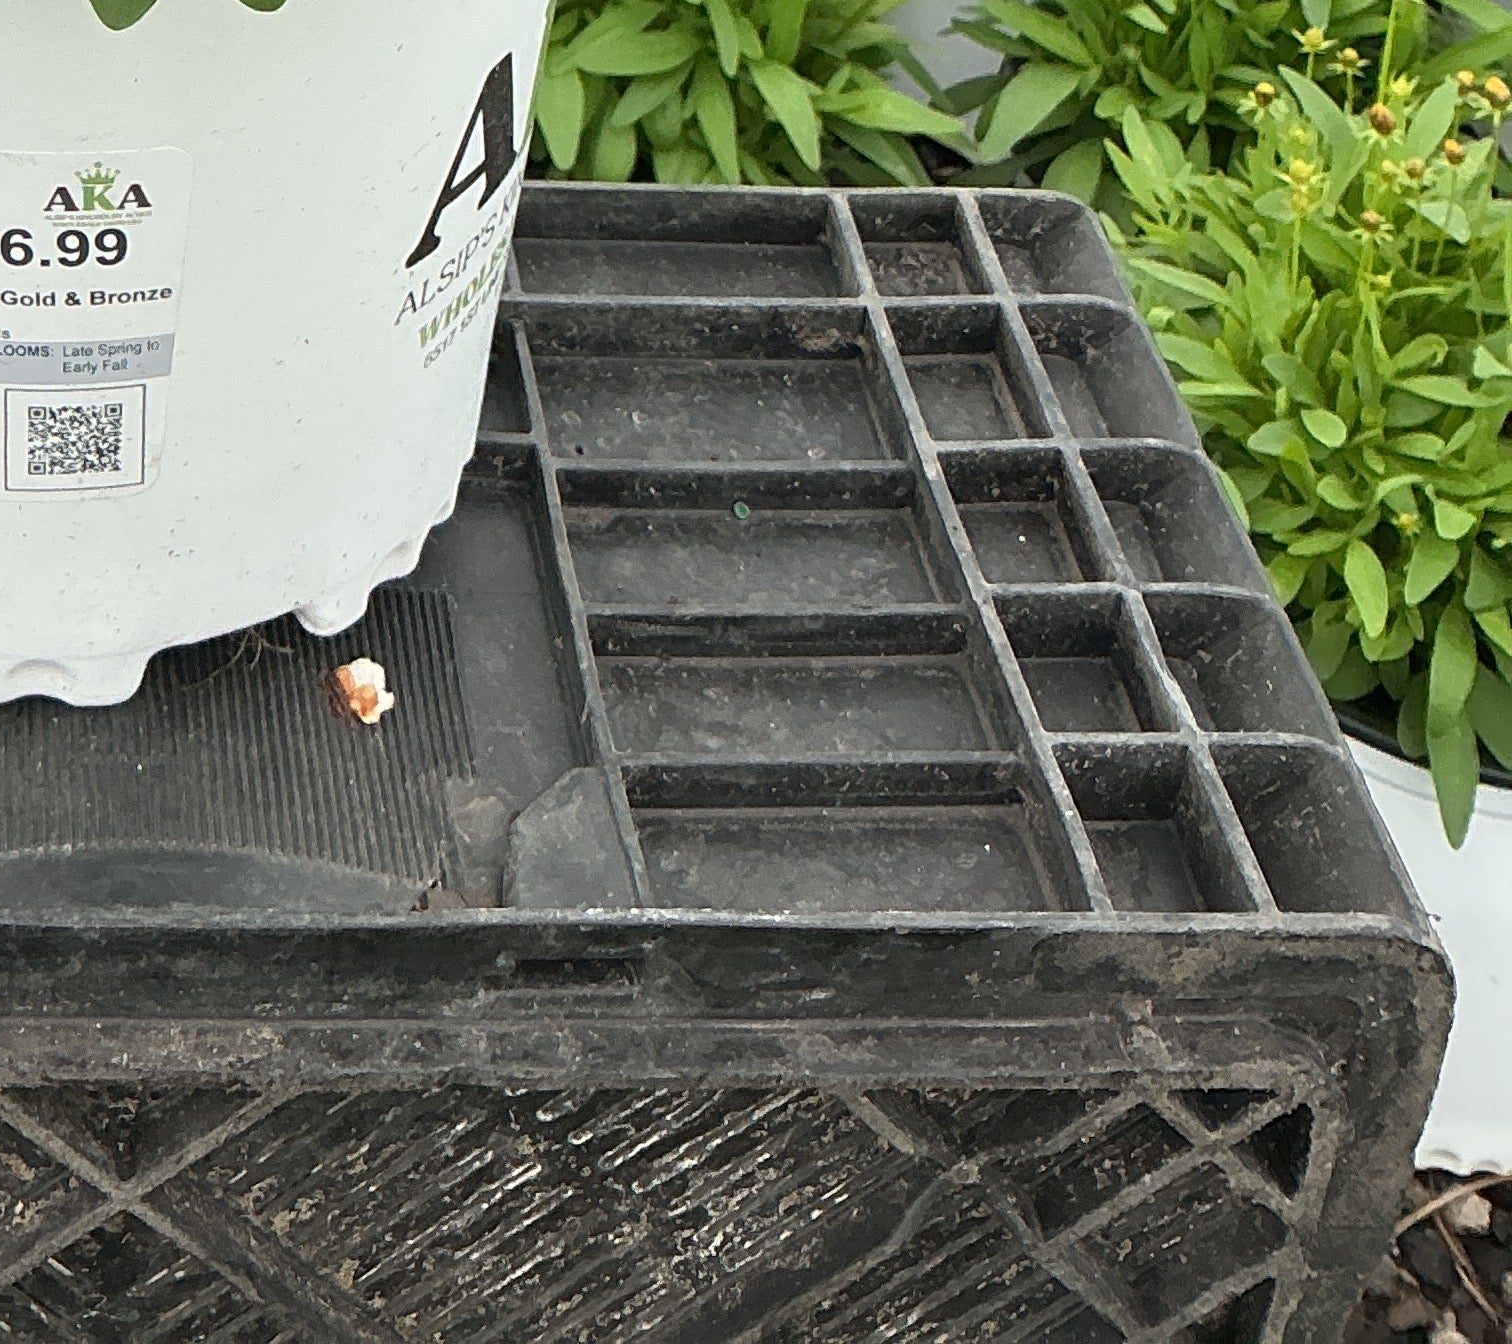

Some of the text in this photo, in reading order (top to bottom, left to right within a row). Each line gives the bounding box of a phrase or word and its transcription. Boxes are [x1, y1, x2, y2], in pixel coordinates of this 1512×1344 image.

[43, 183, 152, 212] AKA
[393, 212, 498, 326] ALSIP'S
[0, 290, 56, 307] Gold
[64, 291, 82, 306] &
[90, 287, 173, 306] Bronze
[62, 345, 94, 358] Late
[97, 342, 143, 356] Spring
[146, 340, 161, 352] to
[62, 358, 128, 375] Early Fall
